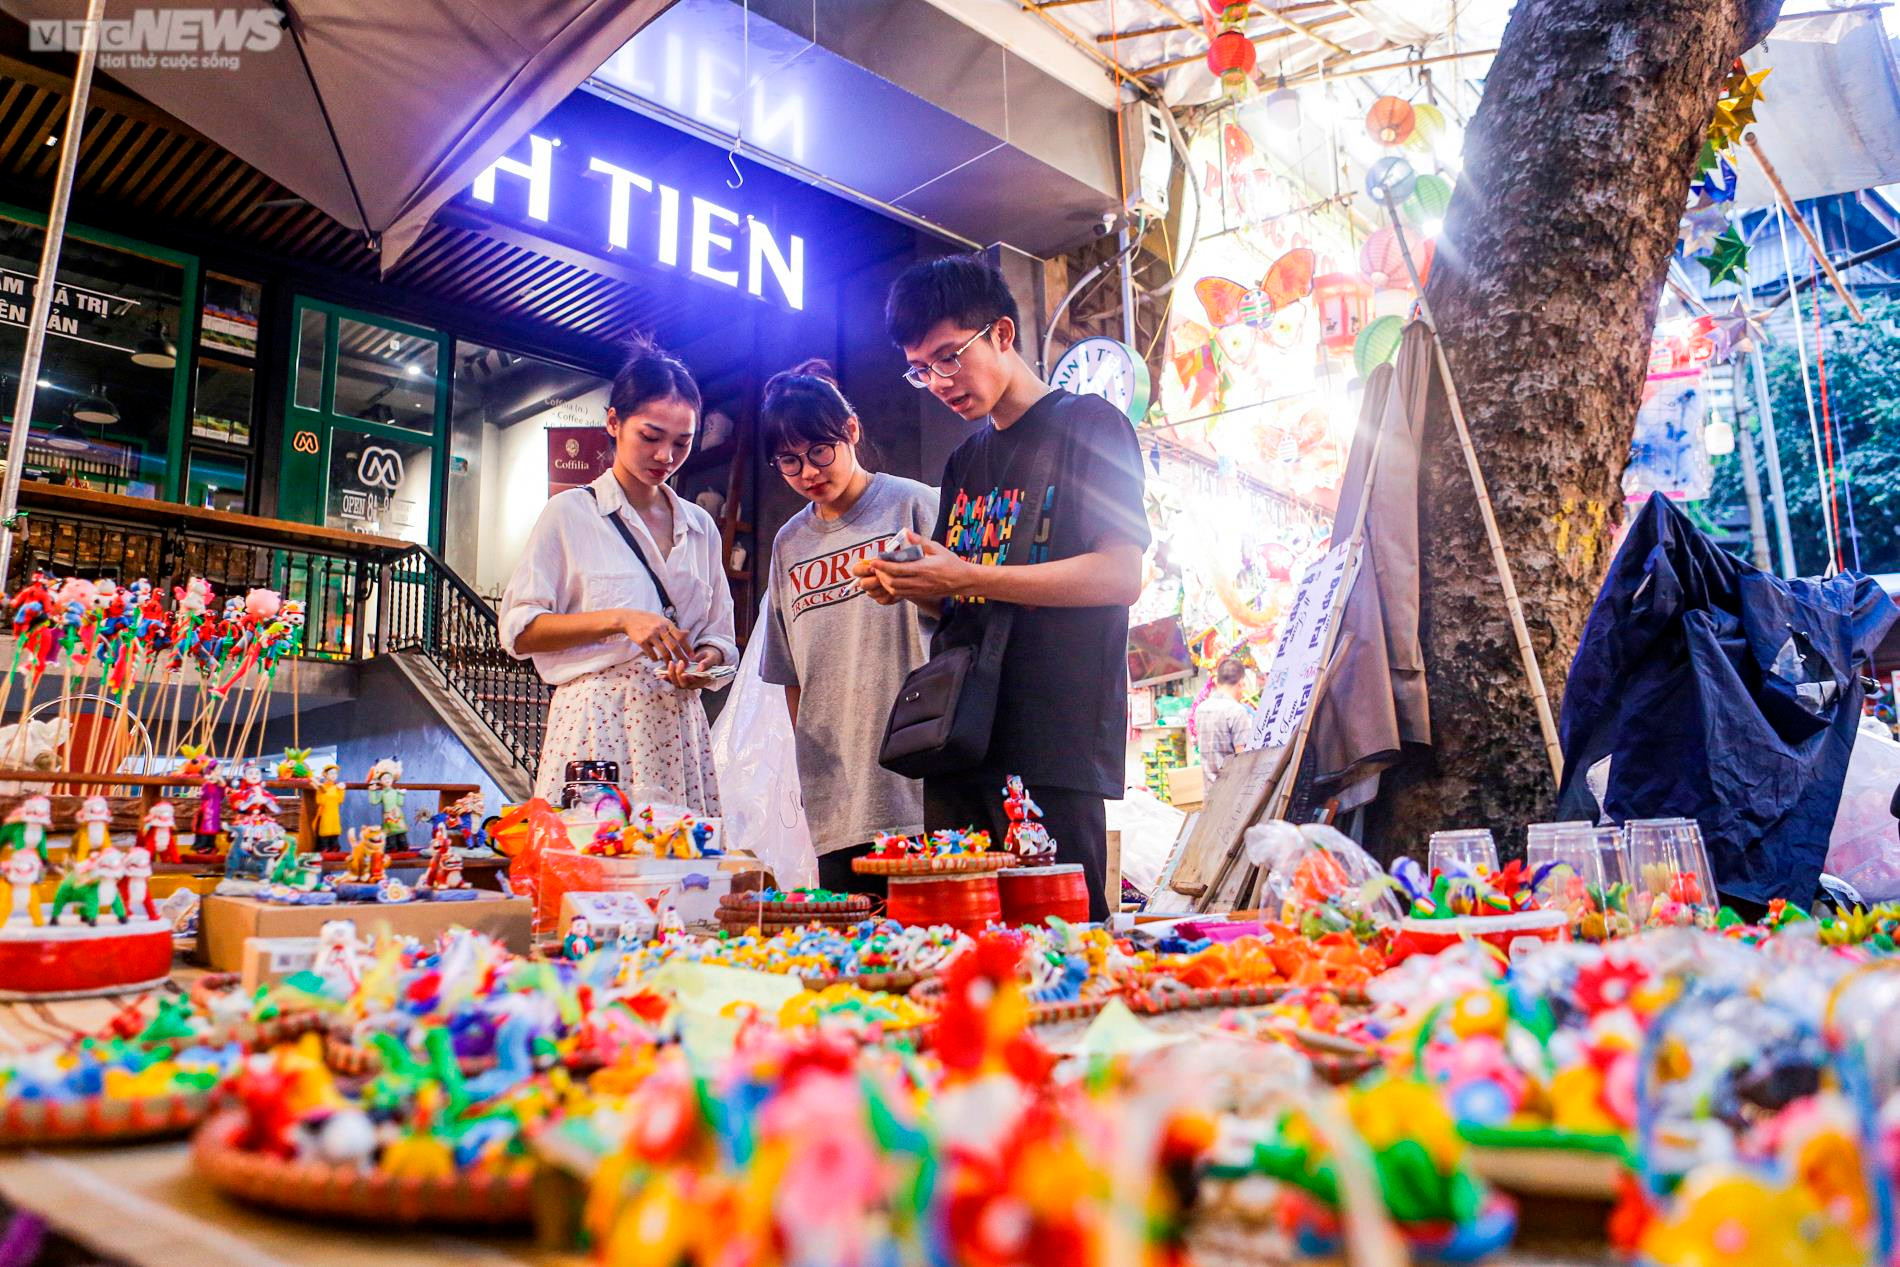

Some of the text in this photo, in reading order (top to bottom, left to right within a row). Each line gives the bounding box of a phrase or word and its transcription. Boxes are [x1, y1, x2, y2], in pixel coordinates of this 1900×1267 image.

[76, 293, 109, 319] TRỊ
[554, 458, 590, 470] Coffilia
[342, 494, 366, 516] OPEN
[789, 537, 900, 595] NORT
